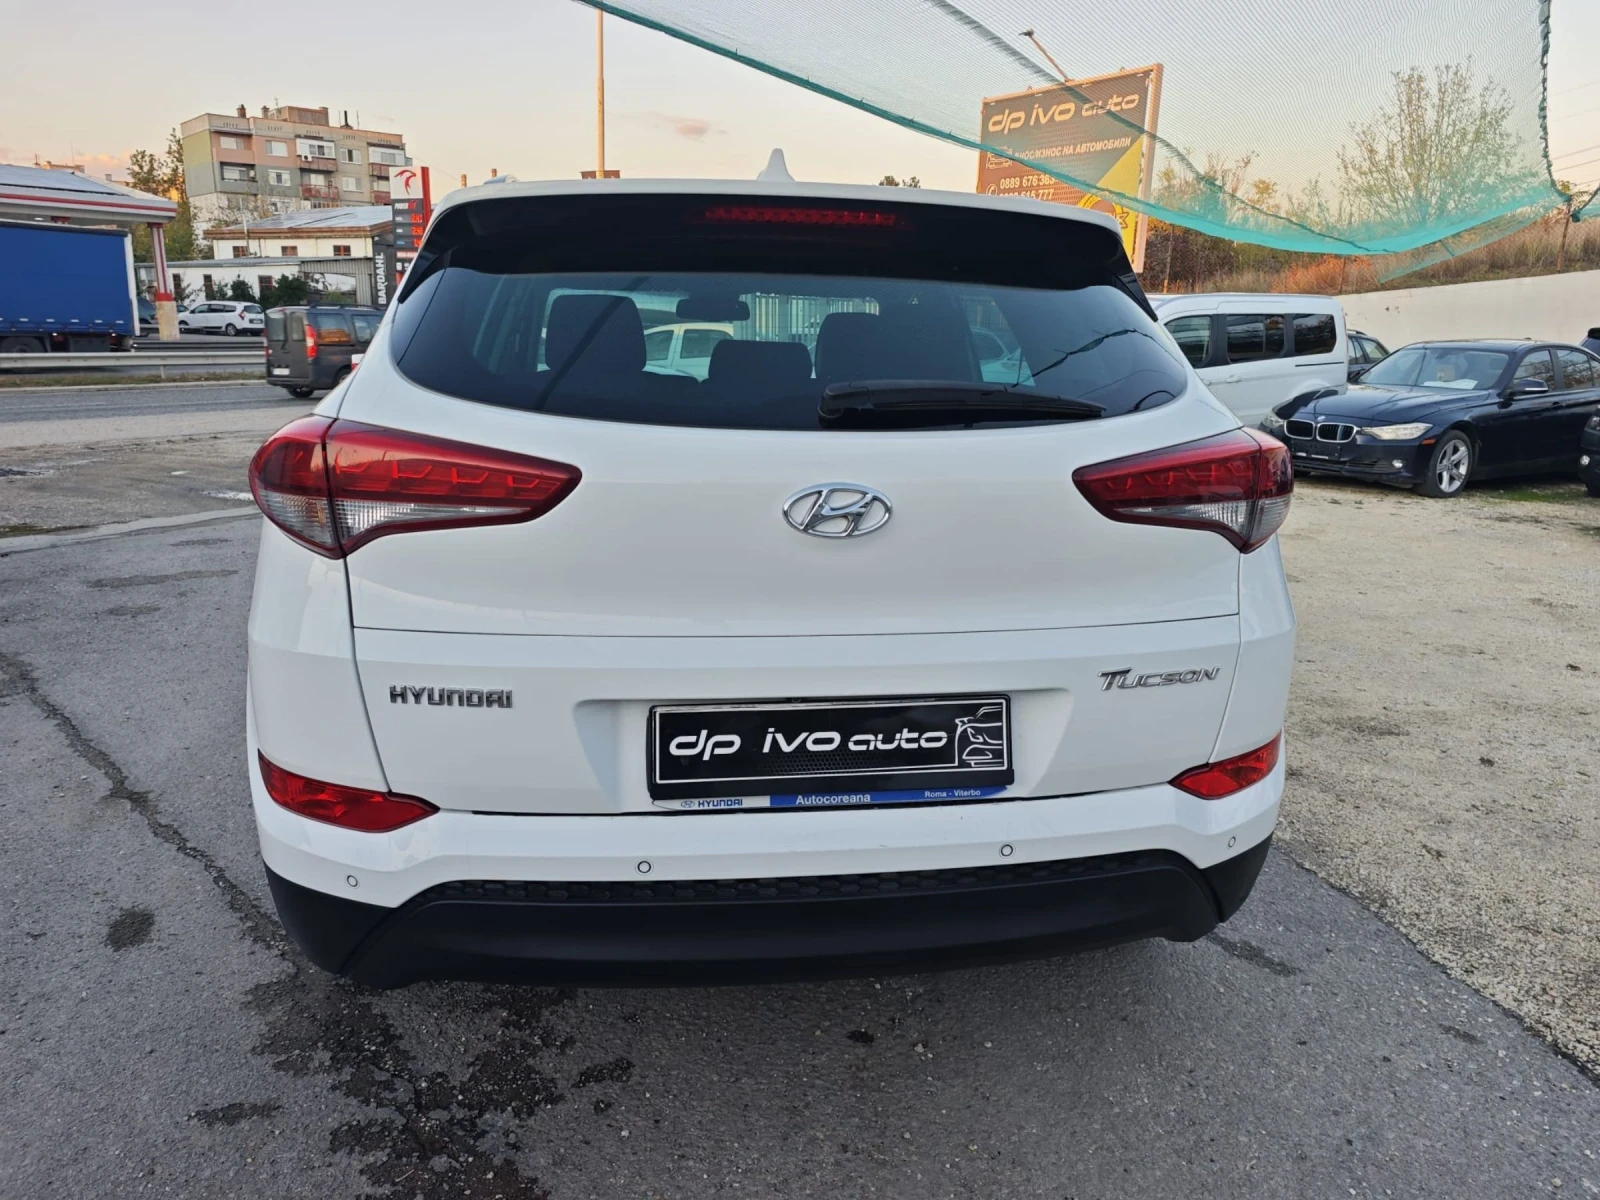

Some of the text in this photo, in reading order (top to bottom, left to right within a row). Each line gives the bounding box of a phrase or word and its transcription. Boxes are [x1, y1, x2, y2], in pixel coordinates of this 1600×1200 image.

[988, 94, 1139, 135] dp ivo auto
[1062, 146, 1074, 156] НА
[1074, 137, 1132, 154] АВТОМОБИЛИ
[1000, 177, 1020, 189] 0889
[1022, 174, 1038, 187] 676
[1038, 188, 1055, 200] 777
[375, 252, 388, 305] BARDAHL
[389, 684, 513, 709] HYUNDAI
[669, 727, 947, 761] dp ivo auto
[795, 793, 871, 805] Autocoreana
[924, 790, 947, 798] Roma
[954, 789, 981, 797] Viterbo
[697, 797, 743, 809] HYUNDAI
